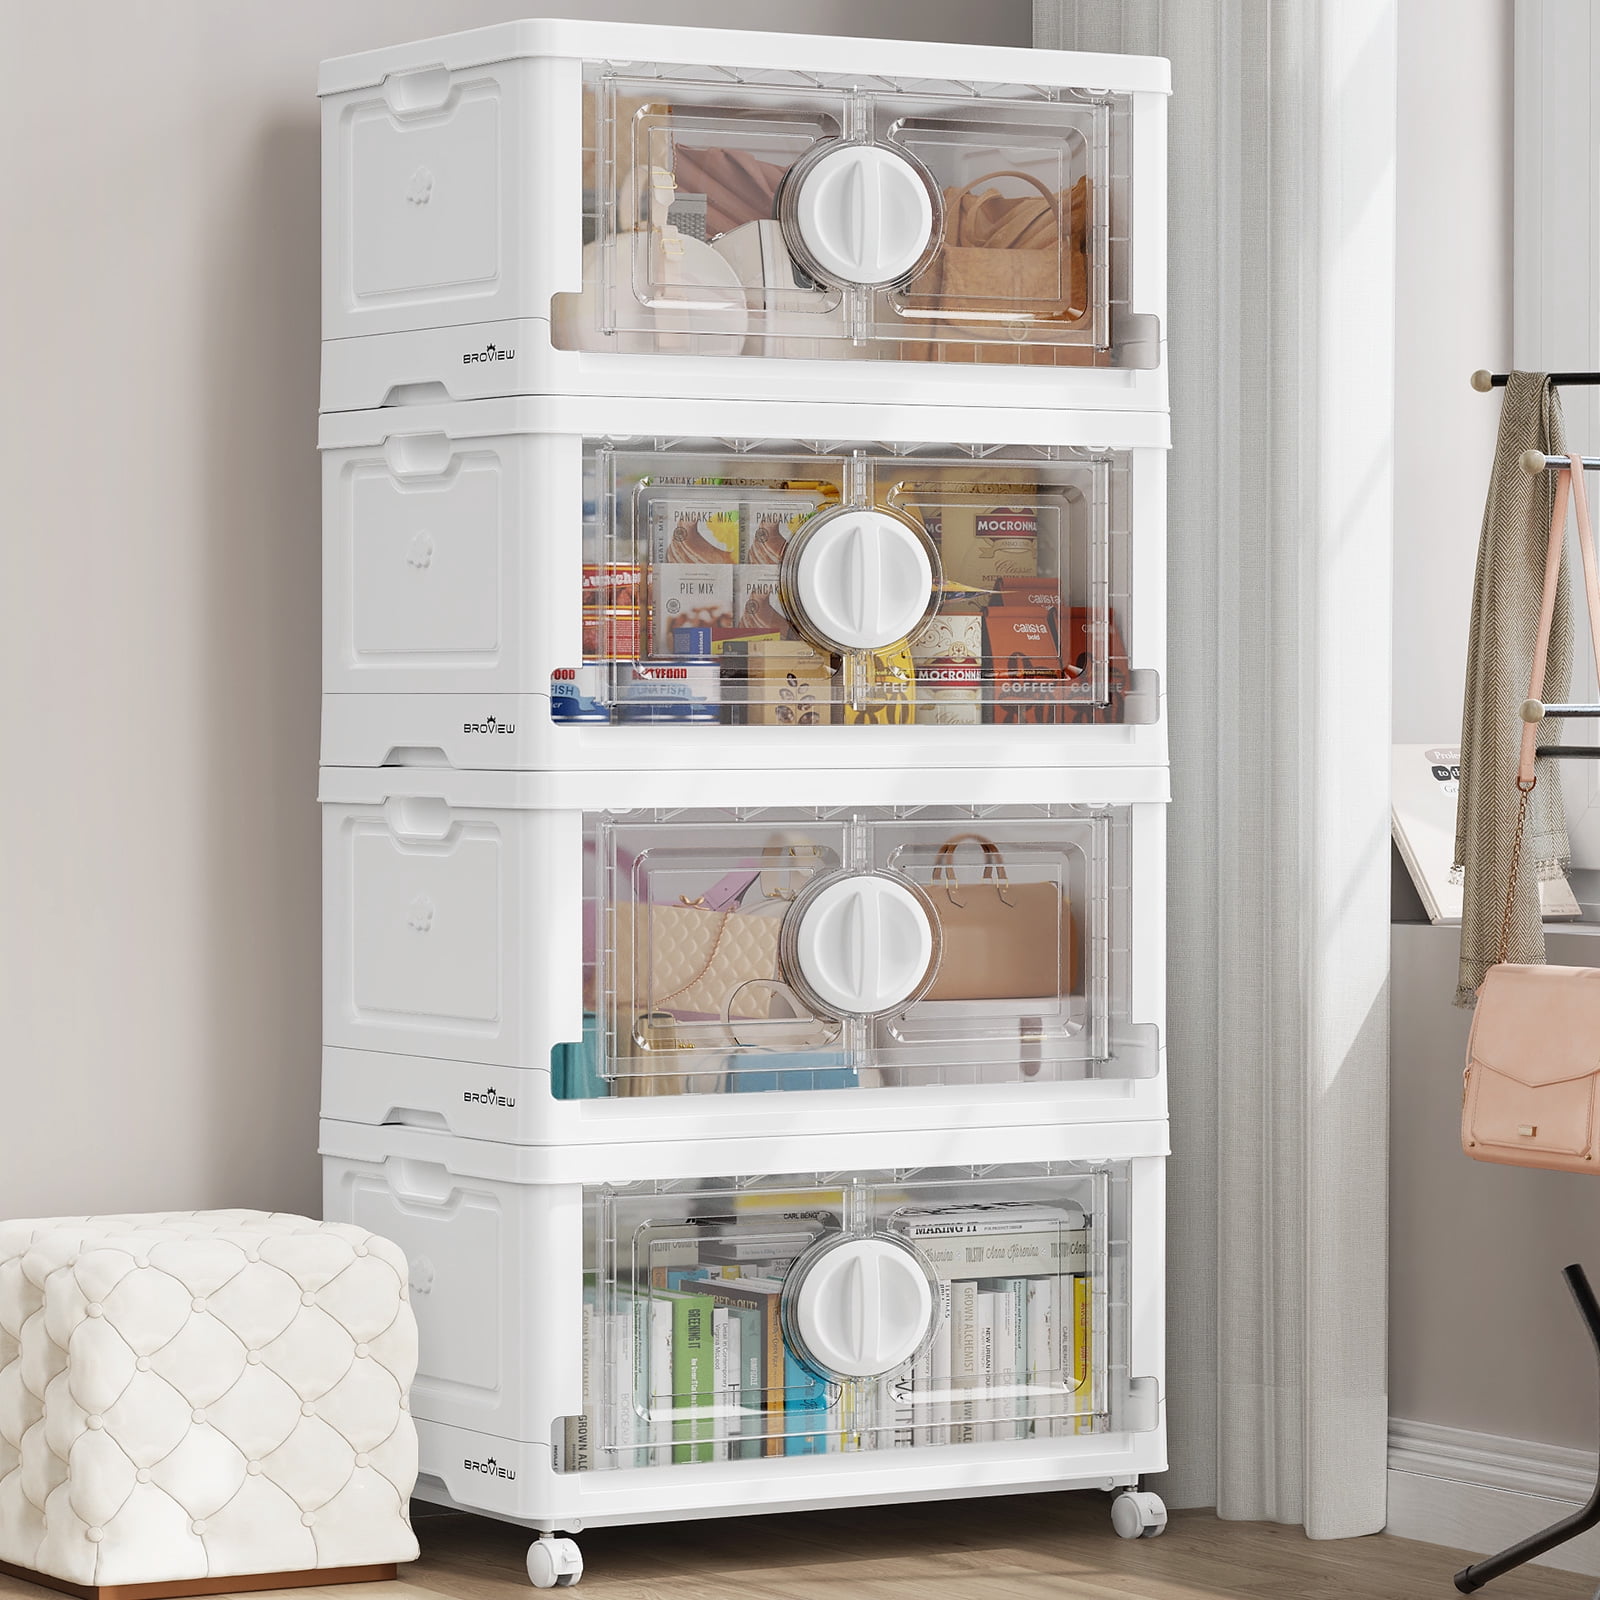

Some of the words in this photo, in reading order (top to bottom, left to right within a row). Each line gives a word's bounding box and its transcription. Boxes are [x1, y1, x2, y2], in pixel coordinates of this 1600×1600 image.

[463, 349, 516, 364] BROVIEW
[674, 510, 713, 523] PANCAKE
[717, 511, 733, 523] MIX
[756, 512, 794, 524] PANCAKE
[680, 582, 694, 595] PIE
[698, 583, 714, 595] MIX
[746, 583, 779, 595] PANCAK
[552, 669, 575, 680] OOD
[660, 685, 687, 697] FISH
[1002, 682, 1056, 693] COFFEE
[463, 722, 516, 734] BROVIEW
[1437, 769, 1449, 777] to
[463, 1091, 516, 1108] BROVIEW
[783, 1212, 800, 1220] CARL
[800, 1211, 819, 1220] BENG
[964, 1287, 974, 1321] GROWN
[688, 1308, 701, 1341] GREENING
[963, 1324, 974, 1372] ALCHEMIST
[578, 1414, 588, 1451] GROWN
[463, 1458, 517, 1480] BROVIEW
